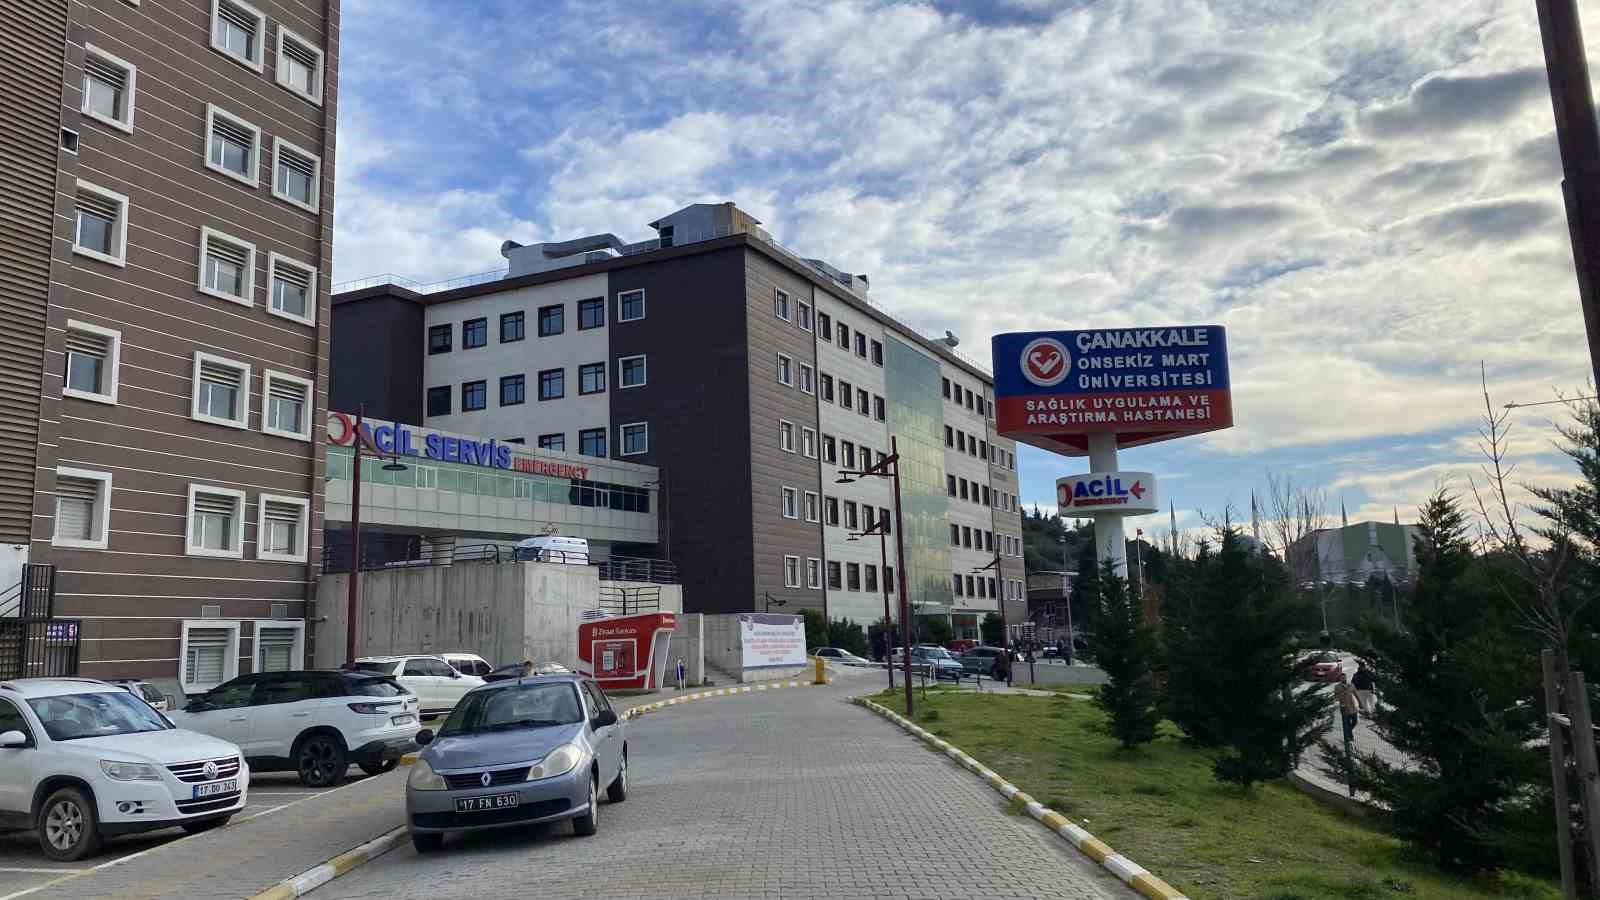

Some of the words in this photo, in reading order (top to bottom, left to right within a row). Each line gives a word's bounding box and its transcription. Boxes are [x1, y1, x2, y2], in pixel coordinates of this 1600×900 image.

[1076, 328, 1208, 354] ÇANAKKALE
[1077, 353, 1154, 369] ONSEKİZ
[1161, 353, 1210, 367] MART
[1078, 369, 1213, 389] ÜNİVERSİTESİ
[1026, 398, 1086, 411] SAĞLIK
[1093, 396, 1183, 409] UYGULAMA
[1189, 394, 1210, 406] VE
[1027, 410, 1118, 425] ARAŞTIRMA
[1123, 406, 1211, 422] HASTANESİ
[425, 432, 512, 470] SERVİS
[1074, 474, 1128, 497] ACİL
[464, 800, 474, 810] 17
[480, 798, 492, 808] FN
[496, 796, 516, 806] 630
